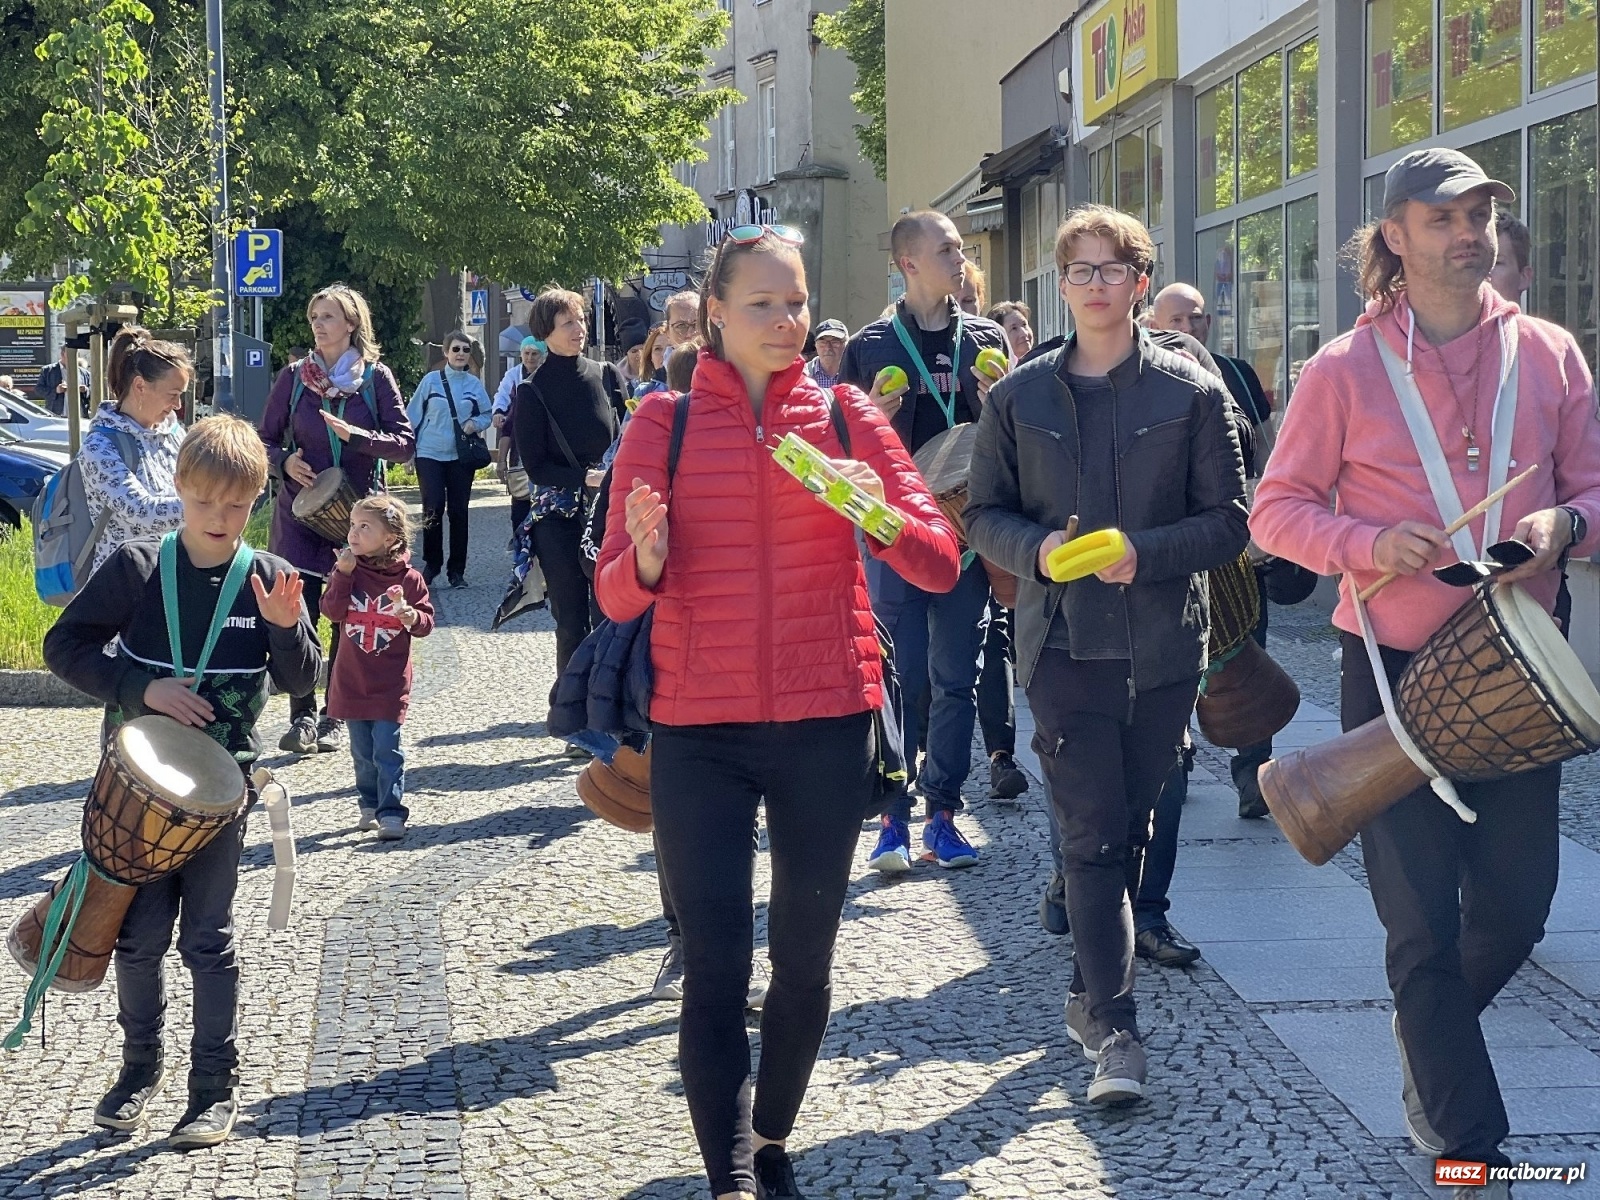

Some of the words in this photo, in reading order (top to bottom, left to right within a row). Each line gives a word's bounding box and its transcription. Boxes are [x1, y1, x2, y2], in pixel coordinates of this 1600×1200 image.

[248, 234, 270, 261] P
[249, 351, 261, 365] P
[222, 616, 256, 628] RTNITE
